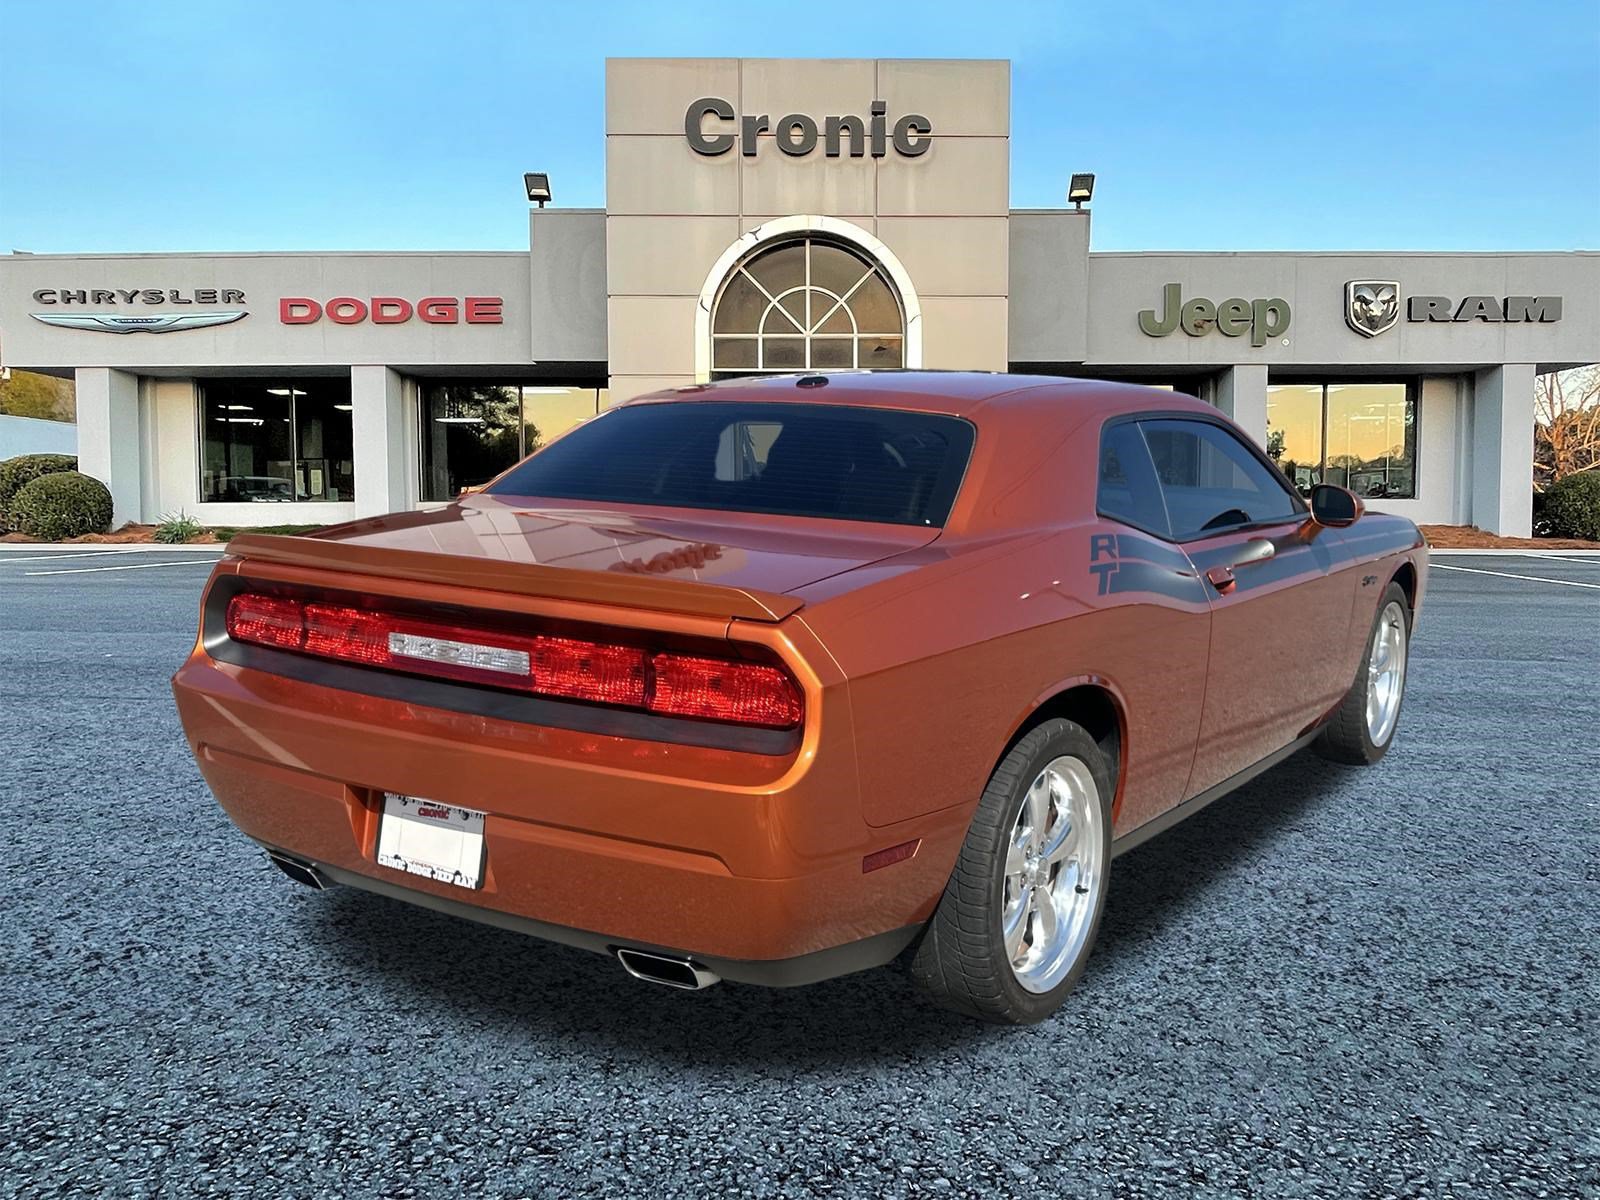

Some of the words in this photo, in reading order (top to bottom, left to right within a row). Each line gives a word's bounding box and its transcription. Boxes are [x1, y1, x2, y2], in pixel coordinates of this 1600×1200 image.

[684, 97, 932, 157] Cronic
[32, 288, 247, 305] CHRYSLER
[1407, 296, 1563, 322] RAM
[279, 296, 504, 325] DODGE
[1138, 283, 1291, 347] Jeep
[418, 807, 449, 820] CRONIC
